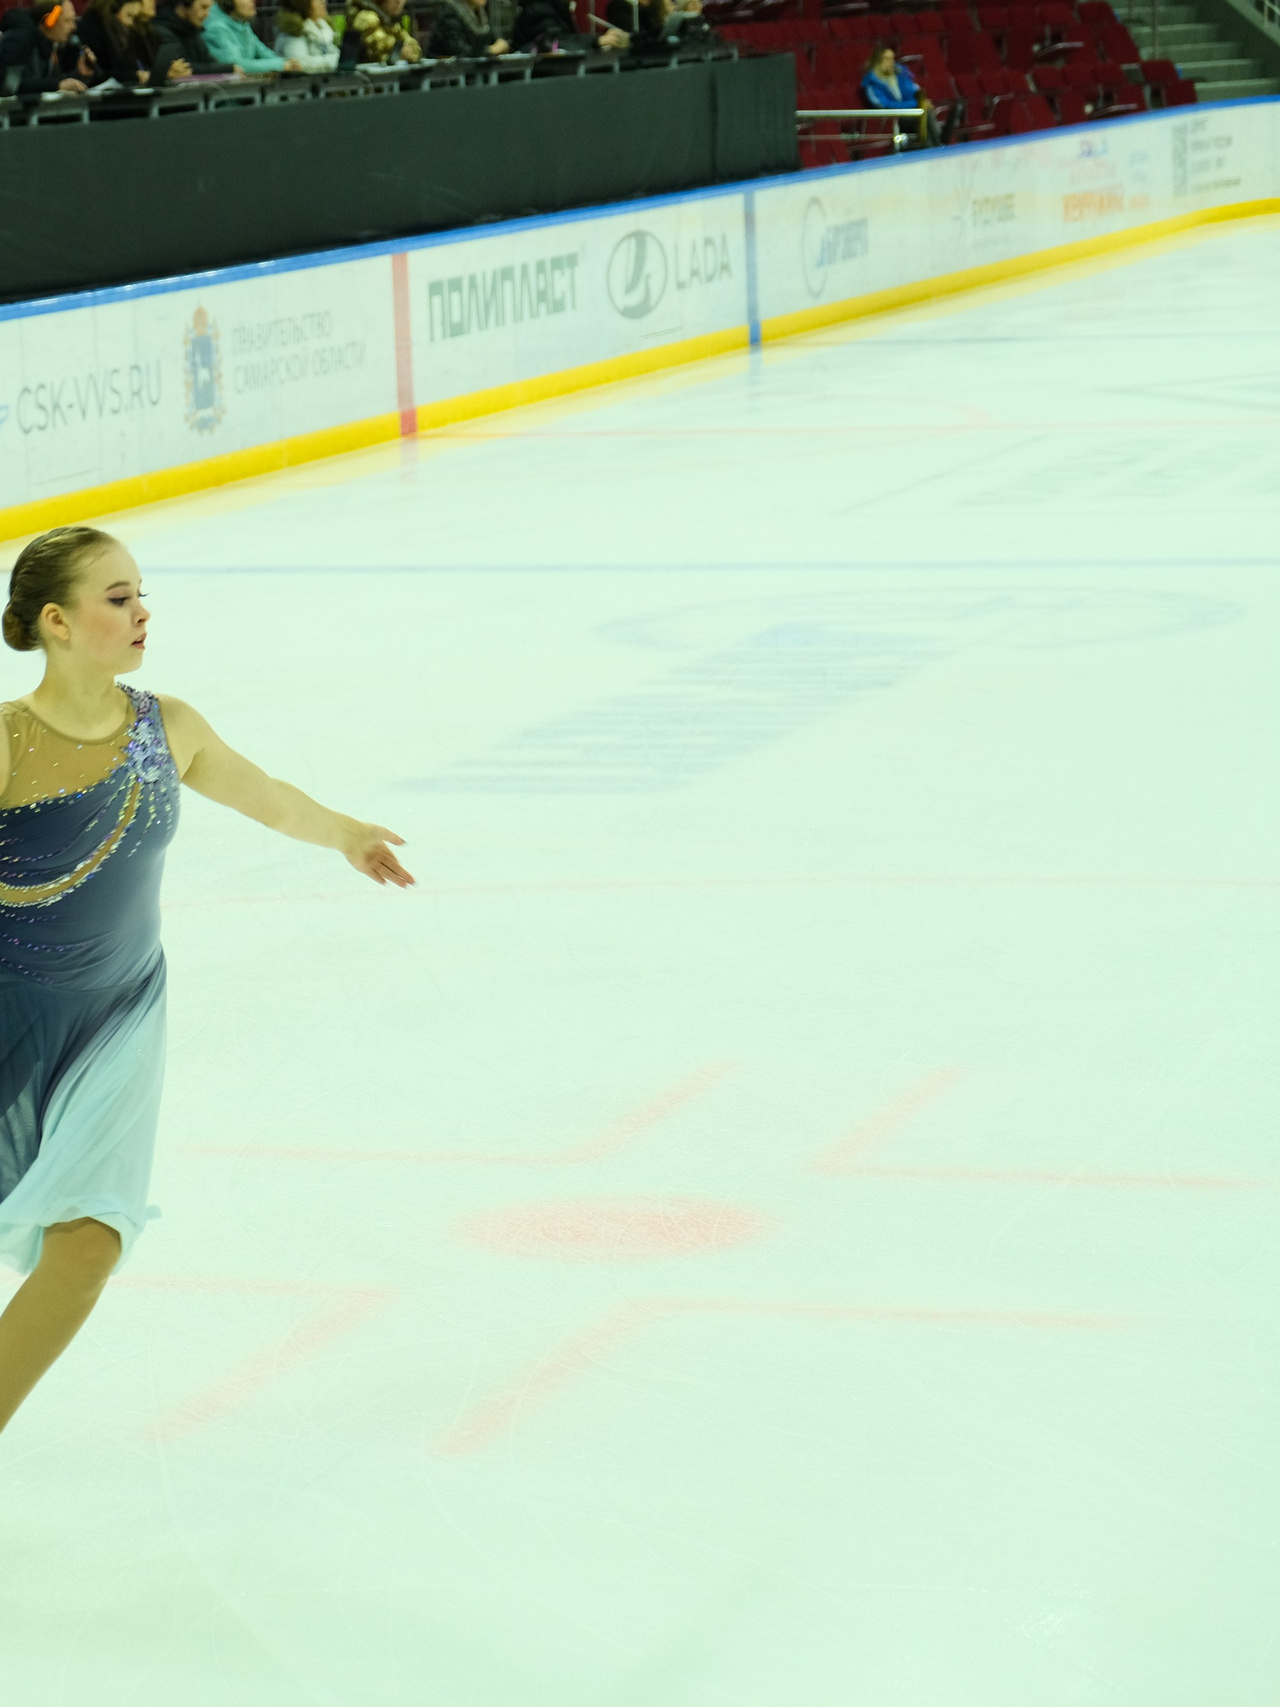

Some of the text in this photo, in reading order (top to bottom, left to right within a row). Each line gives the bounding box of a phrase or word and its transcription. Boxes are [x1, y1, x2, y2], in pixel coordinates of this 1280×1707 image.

[674, 232, 733, 291] LADA
[428, 252, 580, 342] ПОЛИПЛАСТ
[231, 309, 334, 355] ПРАВИТЕЛЬСТВО
[233, 340, 367, 395] САМАРСКОЙ ОБЛАСТИ
[17, 360, 162, 435] CSK-VVS.RU
